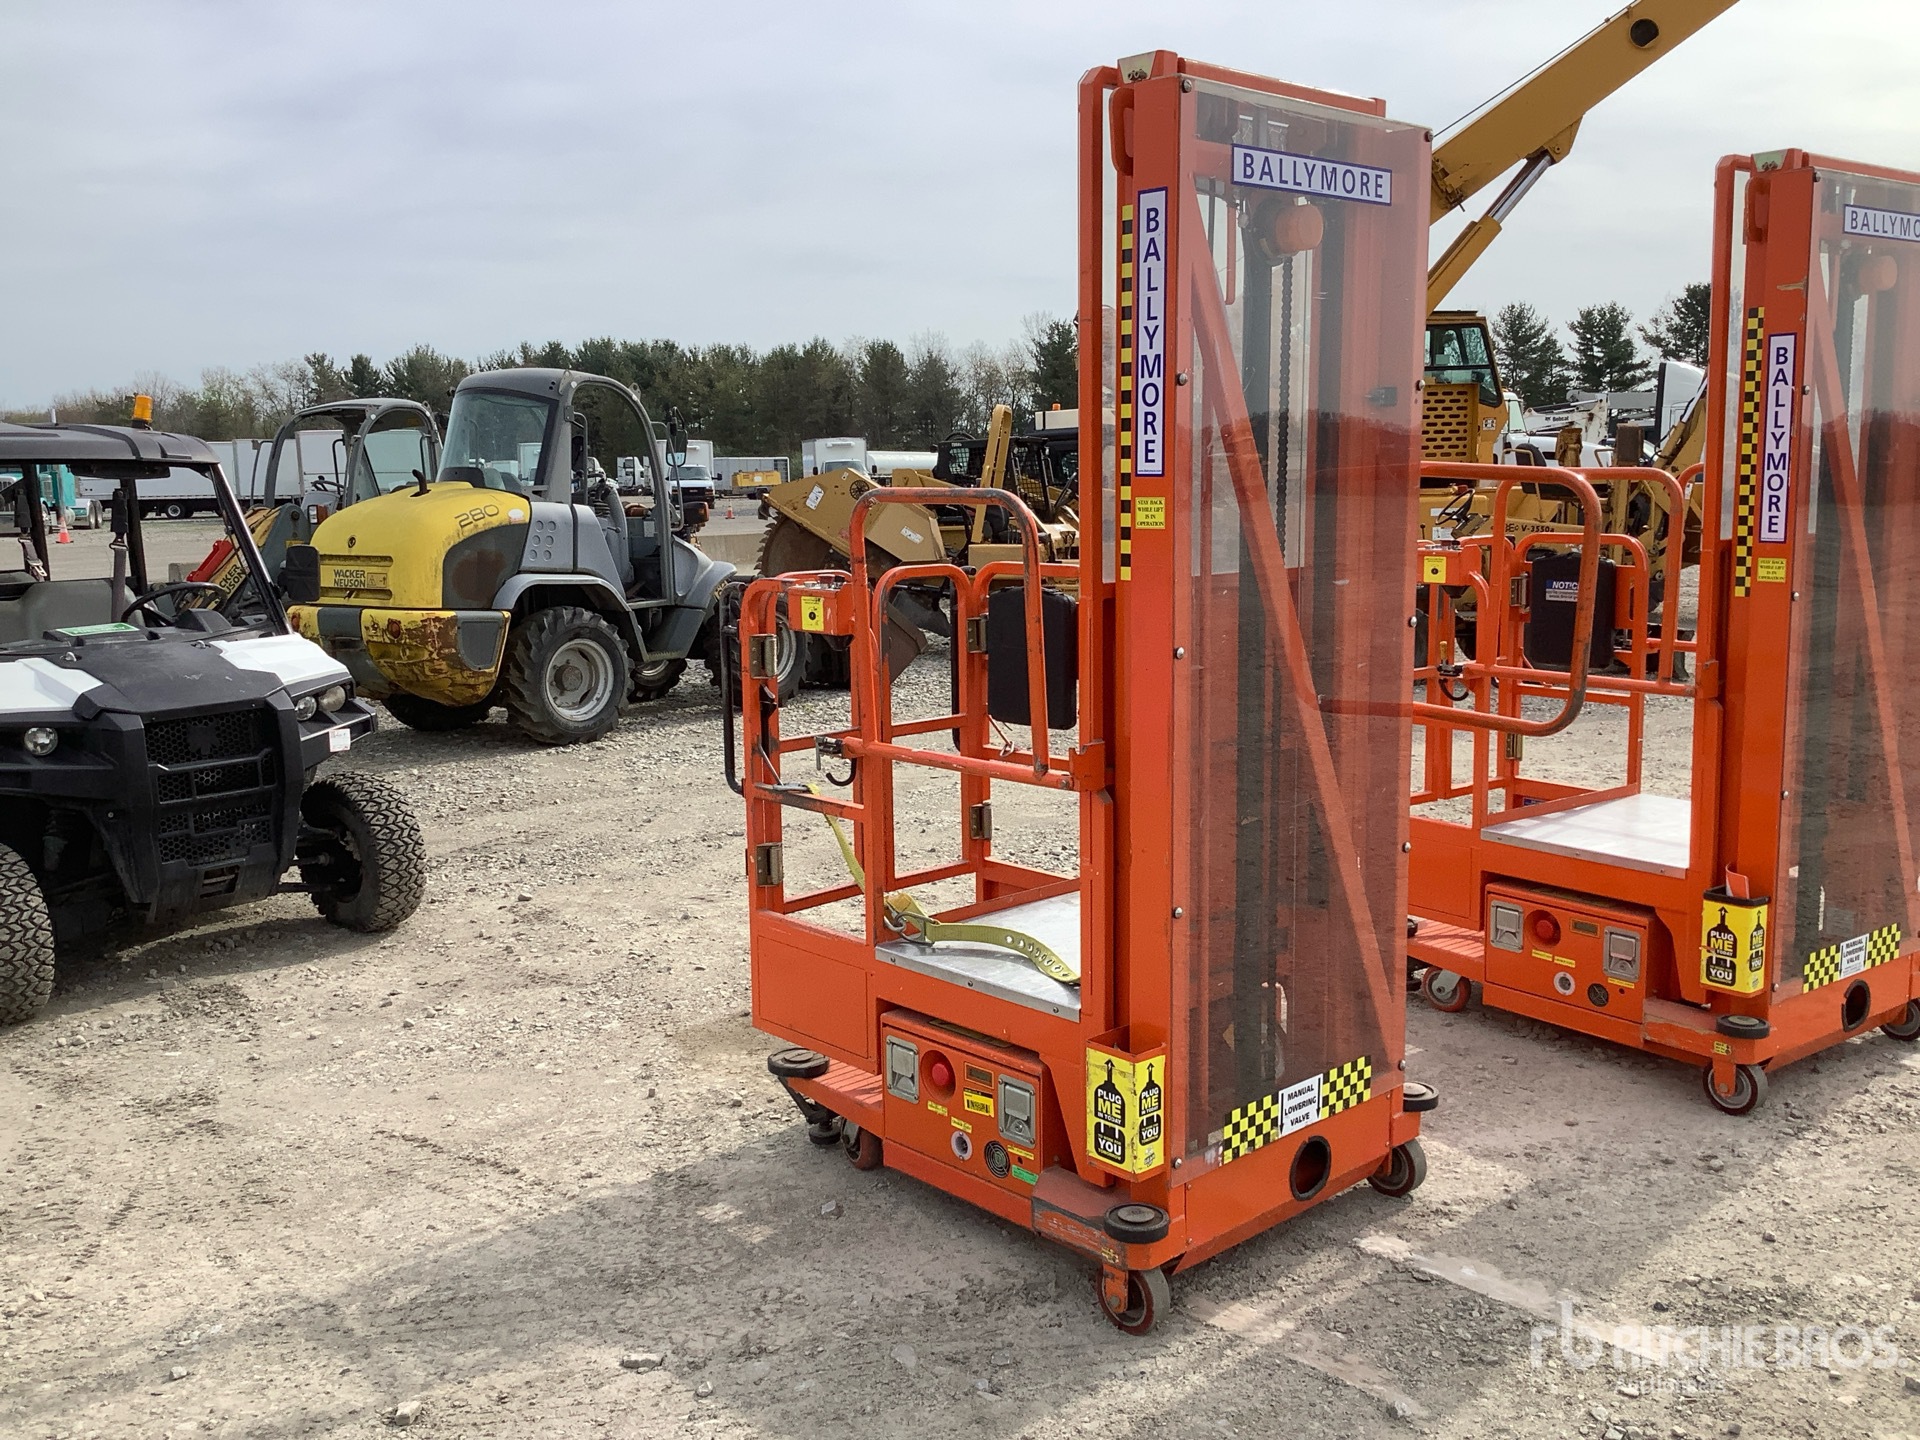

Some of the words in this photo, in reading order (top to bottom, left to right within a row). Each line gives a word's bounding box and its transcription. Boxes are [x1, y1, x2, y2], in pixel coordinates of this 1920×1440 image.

[1243, 152, 1384, 199] BALLYMORE
[1140, 207, 1162, 463] BALLYMORE
[1766, 346, 1789, 534] BALLYMORE
[455, 504, 499, 528] 280
[219, 564, 241, 588] CKER
[333, 569, 365, 578] WACKER
[225, 569, 247, 594] USON
[333, 578, 366, 588] NEUSON
[1552, 581, 1579, 589] NOTIC
[1710, 930, 1734, 941] PLUG
[1711, 938, 1733, 952] ME
[1710, 967, 1732, 980] YOU
[1097, 1089, 1121, 1104] PLUG
[1141, 1087, 1159, 1099] PLUG
[1287, 1083, 1314, 1101] MANUAL
[1098, 1098, 1121, 1118] ME
[1142, 1095, 1158, 1110] ME
[1284, 1096, 1317, 1116] LOWERING
[1104, 1114, 1121, 1125] TODAY
[1290, 1112, 1310, 1126] VALVE
[1142, 1127, 1158, 1140] YOU
[1098, 1138, 1121, 1155] YOU
